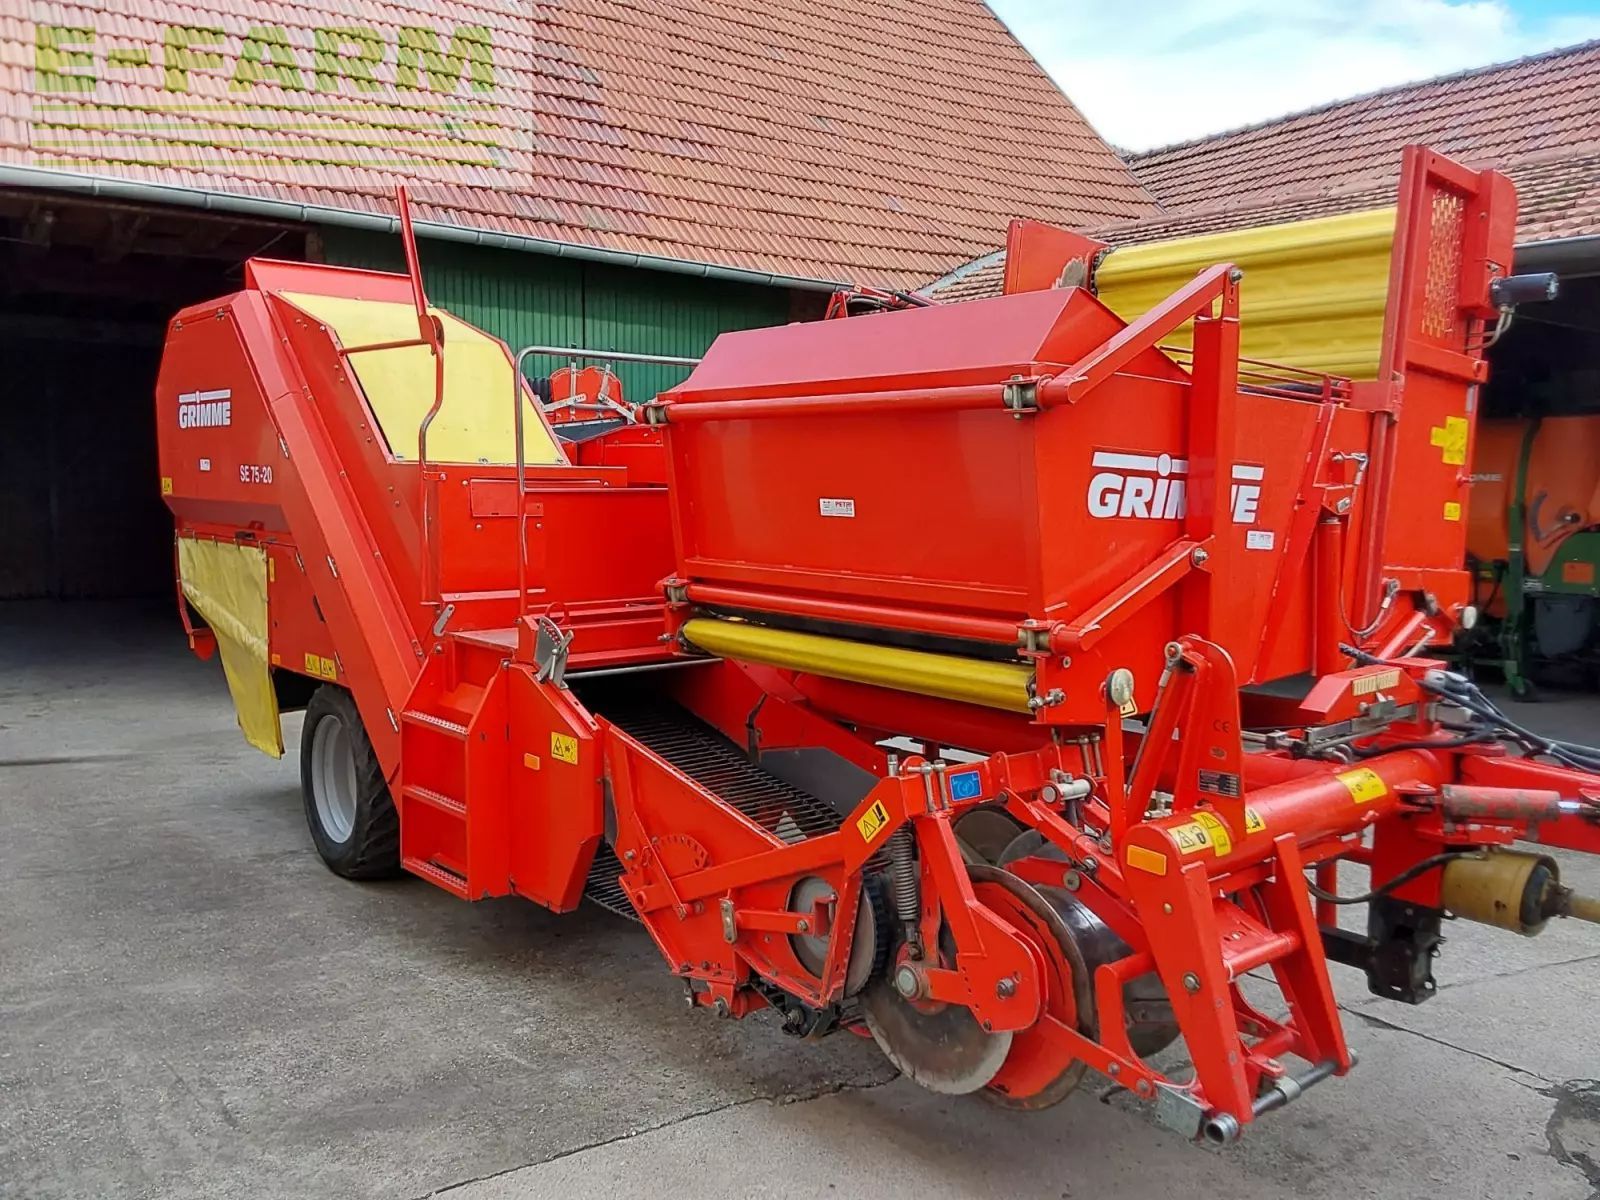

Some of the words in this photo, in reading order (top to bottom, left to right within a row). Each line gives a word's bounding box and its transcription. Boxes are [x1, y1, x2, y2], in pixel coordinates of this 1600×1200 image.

[178, 390, 232, 429] GRIMME
[239, 464, 250, 483] SE
[251, 465, 273, 484] 75-20
[1087, 453, 1261, 524] GRIME
